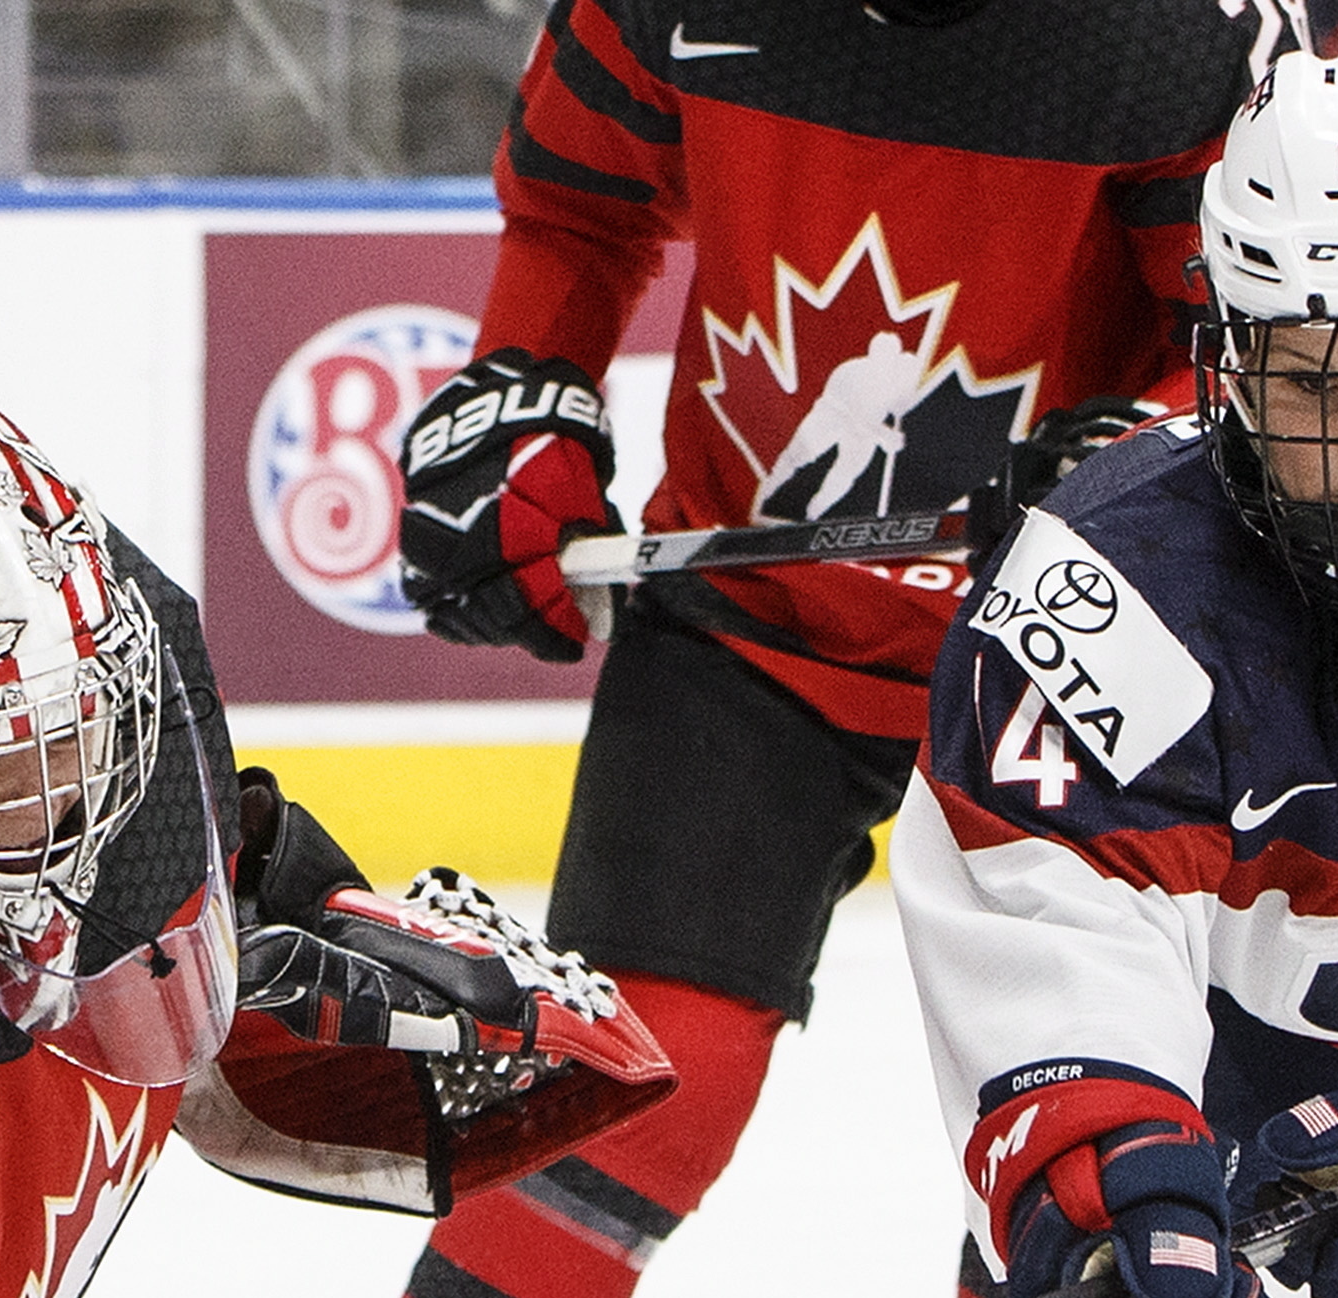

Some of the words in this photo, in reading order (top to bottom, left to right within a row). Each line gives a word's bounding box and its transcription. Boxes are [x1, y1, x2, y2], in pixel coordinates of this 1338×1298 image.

[407, 380, 611, 478] BAUE
[809, 515, 941, 551] NEXUS
[979, 586, 1126, 758] OYOTA
[1011, 1063, 1085, 1093] DECKER
